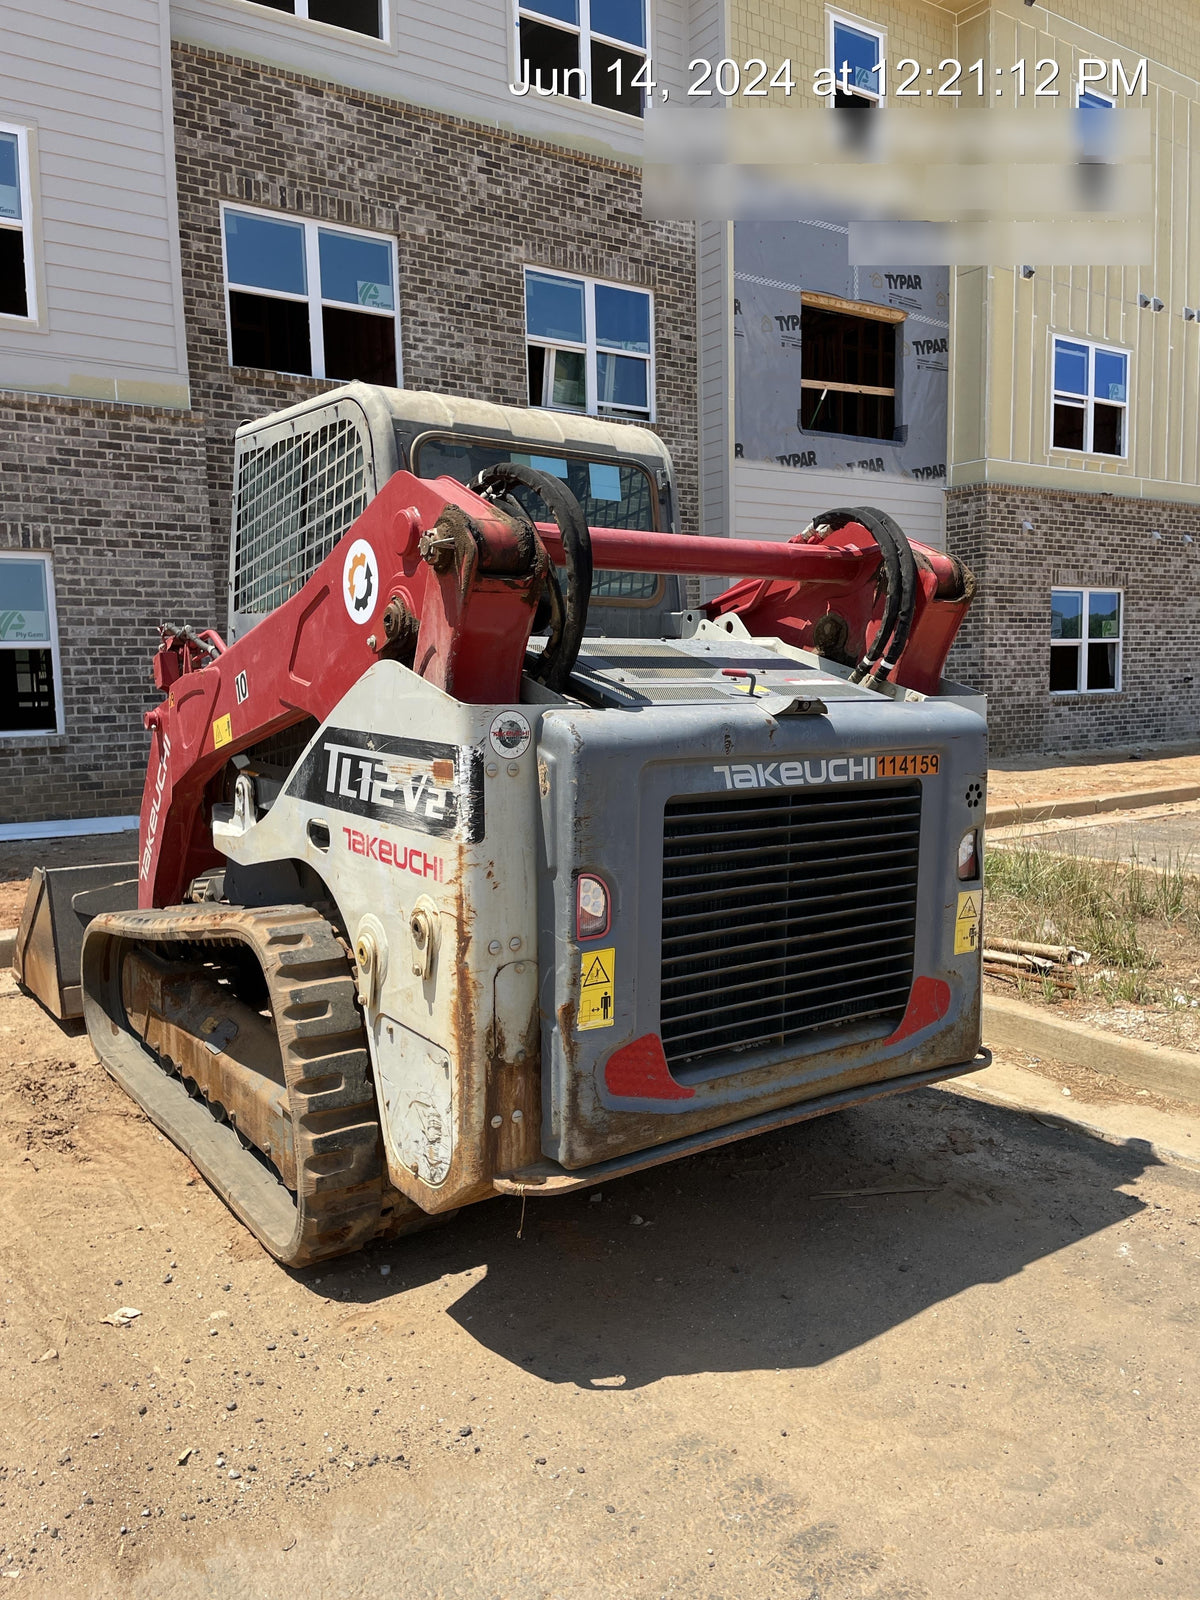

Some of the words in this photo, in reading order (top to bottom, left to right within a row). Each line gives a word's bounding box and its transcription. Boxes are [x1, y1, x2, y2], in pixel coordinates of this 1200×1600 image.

[884, 274, 923, 290] TYPAR
[774, 314, 802, 332] TYP
[912, 338, 949, 356] TYPAR
[776, 450, 818, 468] TYPAR
[236, 673, 247, 703] 10
[878, 754, 939, 776] 114159
